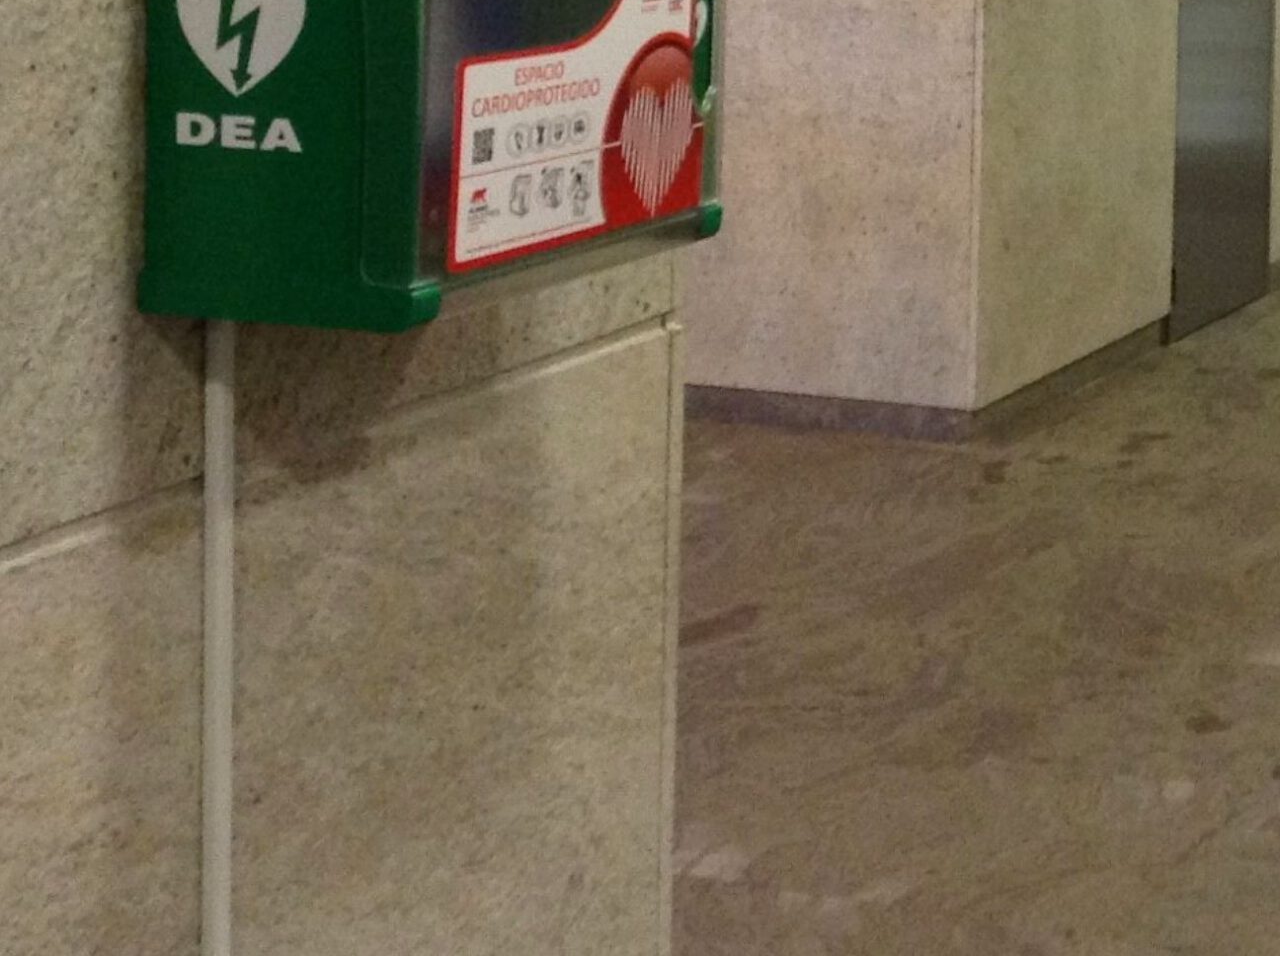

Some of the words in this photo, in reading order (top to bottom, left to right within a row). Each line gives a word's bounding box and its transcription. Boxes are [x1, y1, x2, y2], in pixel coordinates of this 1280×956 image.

[514, 61, 565, 86] ESPACIO
[471, 78, 601, 118] CARDIOPROTEGIDO
[175, 112, 303, 153] DEA
